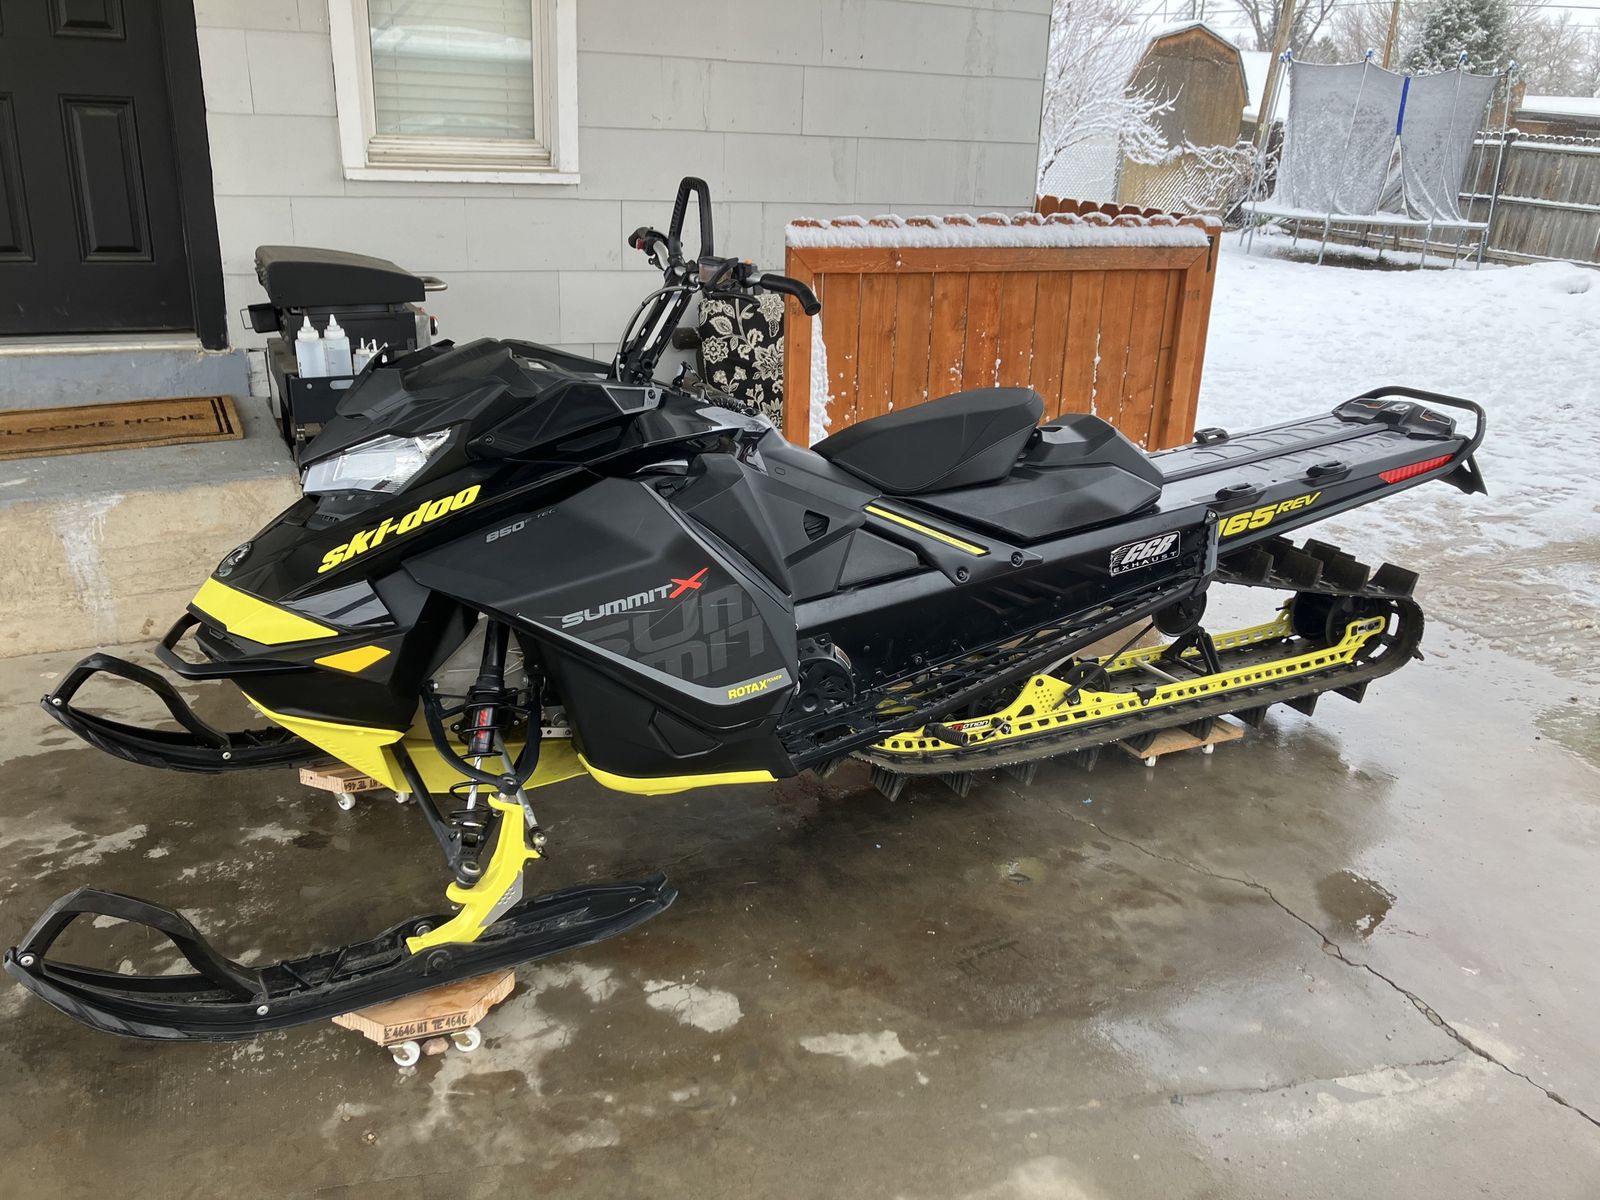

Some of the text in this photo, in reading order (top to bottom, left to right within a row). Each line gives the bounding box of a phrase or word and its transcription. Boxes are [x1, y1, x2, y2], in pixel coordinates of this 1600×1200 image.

[125, 413, 206, 425] HOME
[1276, 491, 1322, 515] REV
[317, 484, 482, 574] ski-doo
[486, 520, 525, 544] 850
[1120, 534, 1178, 565] GGB
[1113, 551, 1177, 573] EXHAUST
[561, 567, 709, 629] SUMMIT X
[728, 679, 768, 700] ROTAX
[393, 1024, 416, 1038] 4646
[416, 1021, 428, 1033] HT
[445, 1014, 468, 1028] 4646
